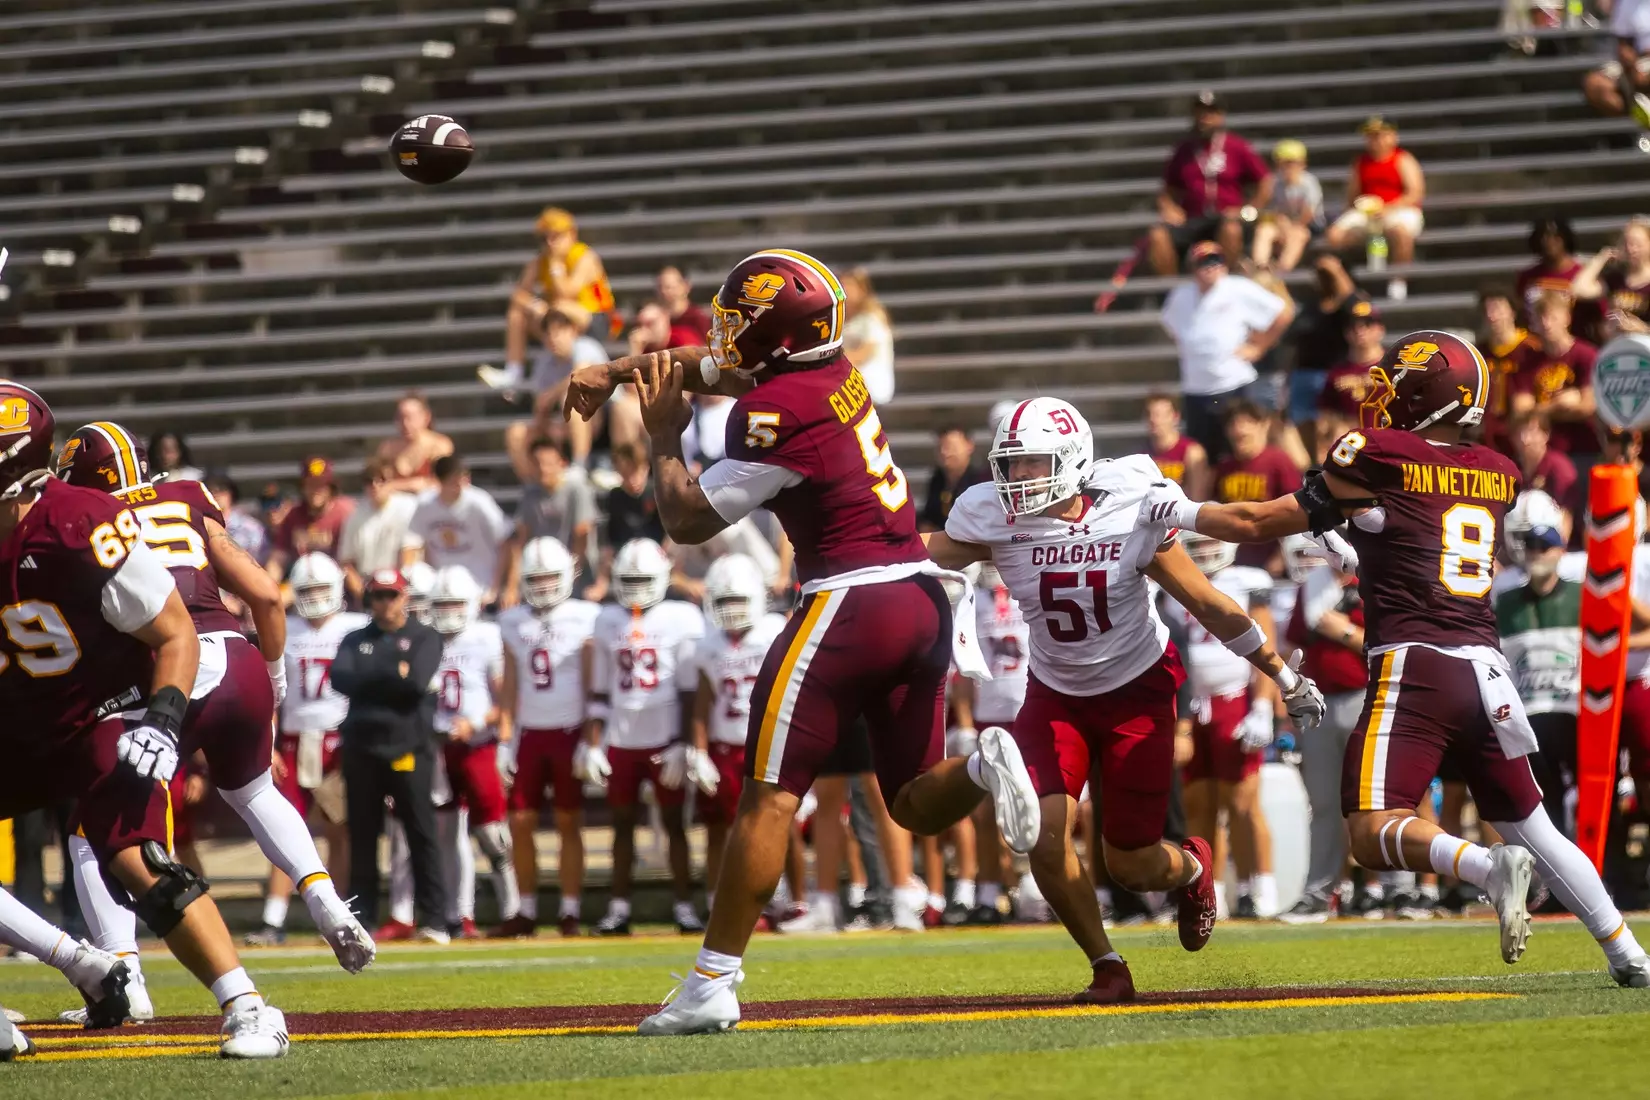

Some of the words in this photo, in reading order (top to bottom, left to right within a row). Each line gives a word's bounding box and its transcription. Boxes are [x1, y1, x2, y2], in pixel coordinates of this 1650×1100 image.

[745, 411, 781, 449] 5
[1047, 408, 1079, 436] 51
[853, 404, 908, 513] 5
[1332, 431, 1366, 467] 8
[1401, 463, 1433, 493] VAN
[89, 508, 141, 569] 69
[1031, 542, 1122, 567] COLGATE
[1439, 502, 1496, 598] 8
[1040, 570, 1113, 642] 51
[0, 598, 82, 678] 9
[531, 649, 552, 691] 9
